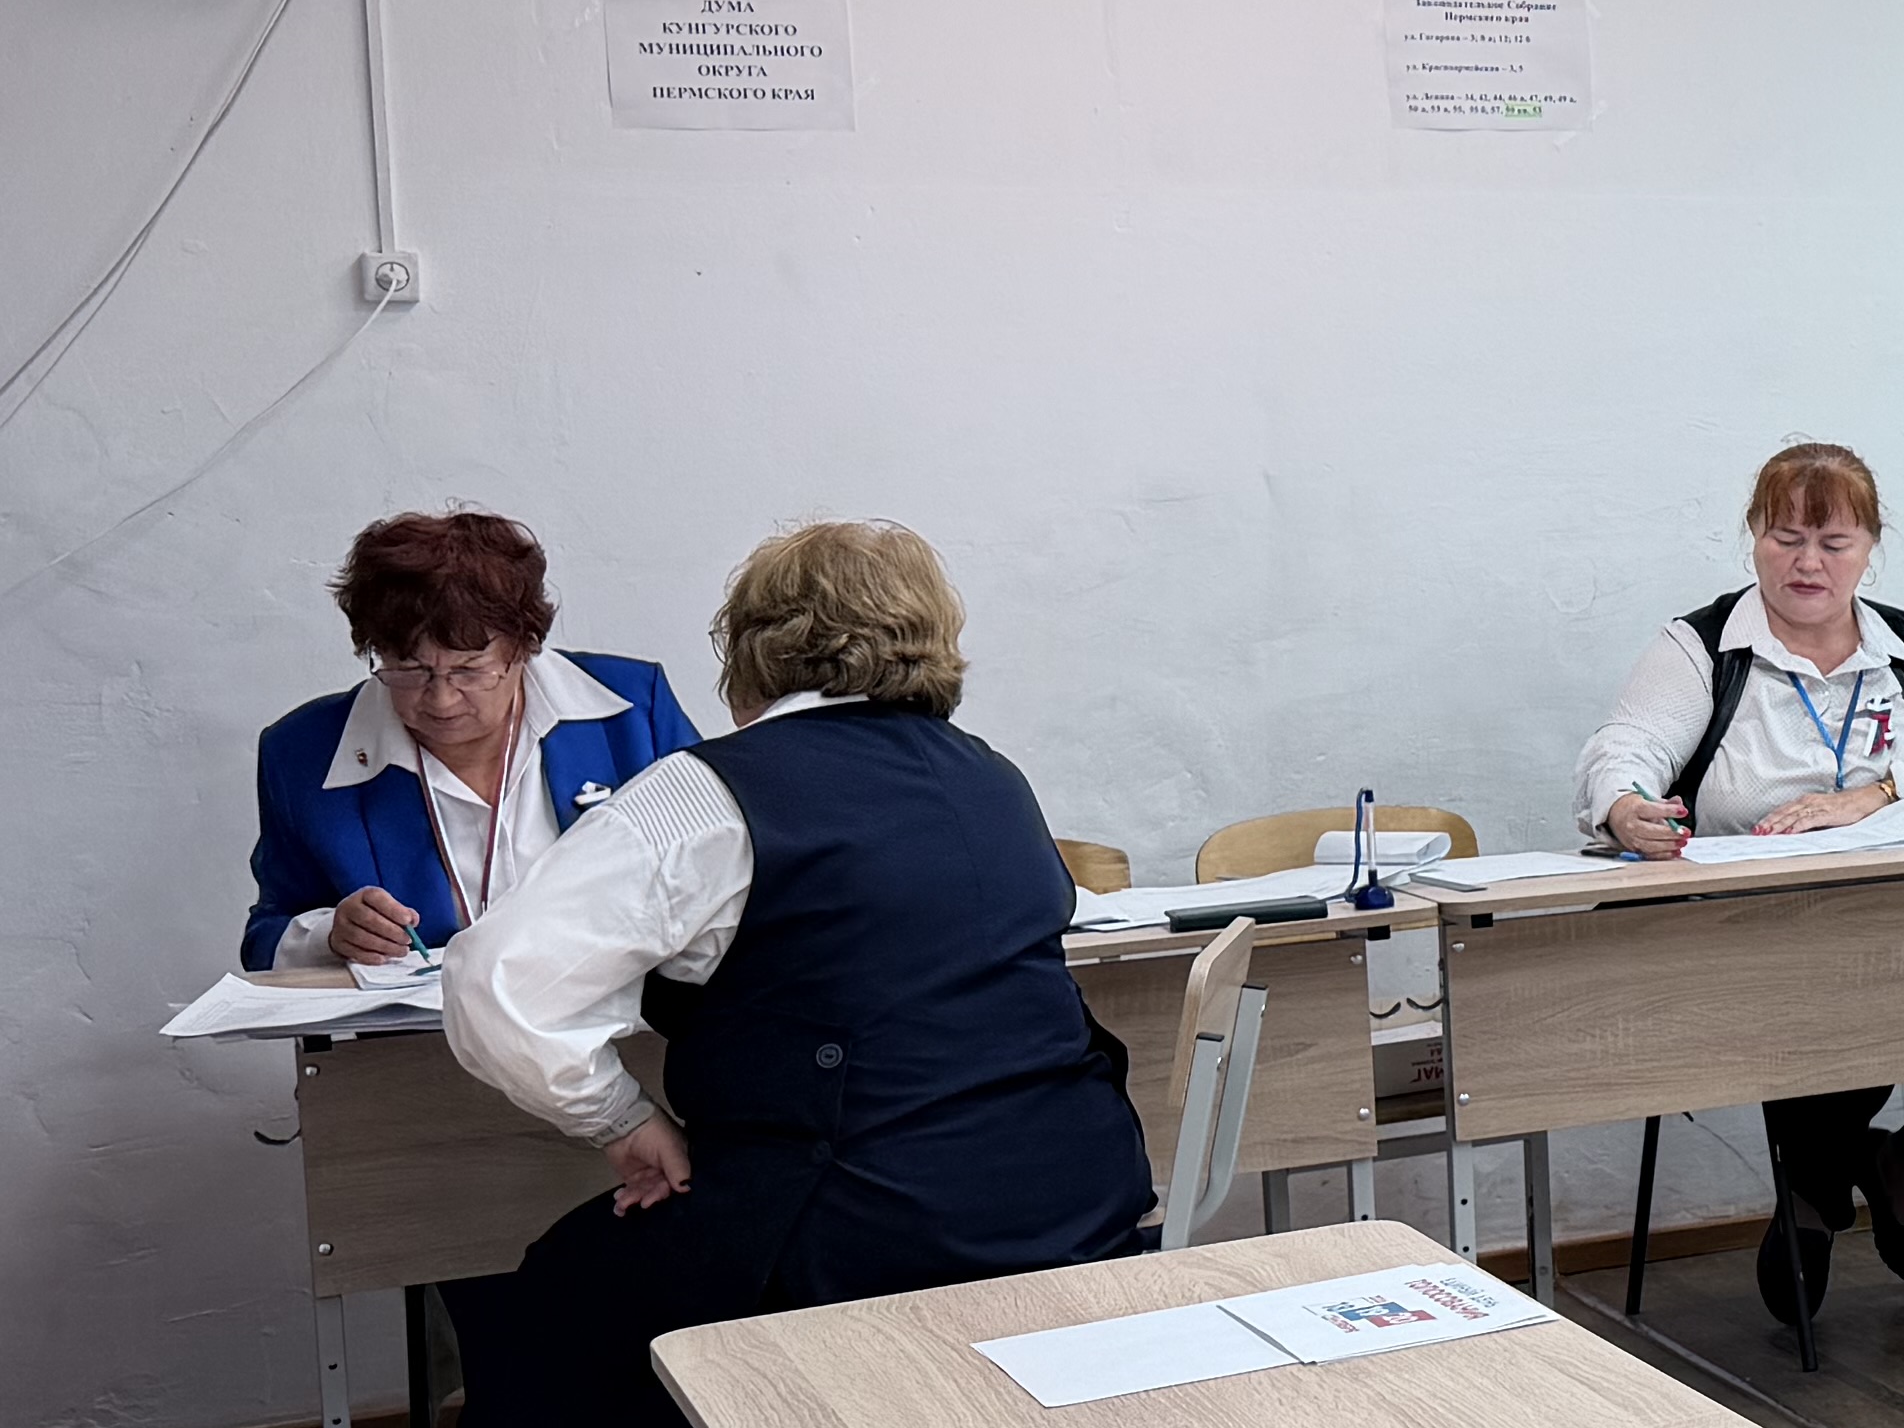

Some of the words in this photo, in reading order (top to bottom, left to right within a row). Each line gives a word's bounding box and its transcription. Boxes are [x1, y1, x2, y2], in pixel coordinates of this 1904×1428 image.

[700, 0, 755, 14] ДУМА
[662, 22, 797, 37] КУНГУРСКОГО
[639, 42, 823, 58] МУНИЦИПАЛЬНОГО
[697, 64, 768, 78] ОКРУГА
[652, 86, 766, 101] ПЕРМСКОГО
[771, 88, 816, 101] КРАЯ
